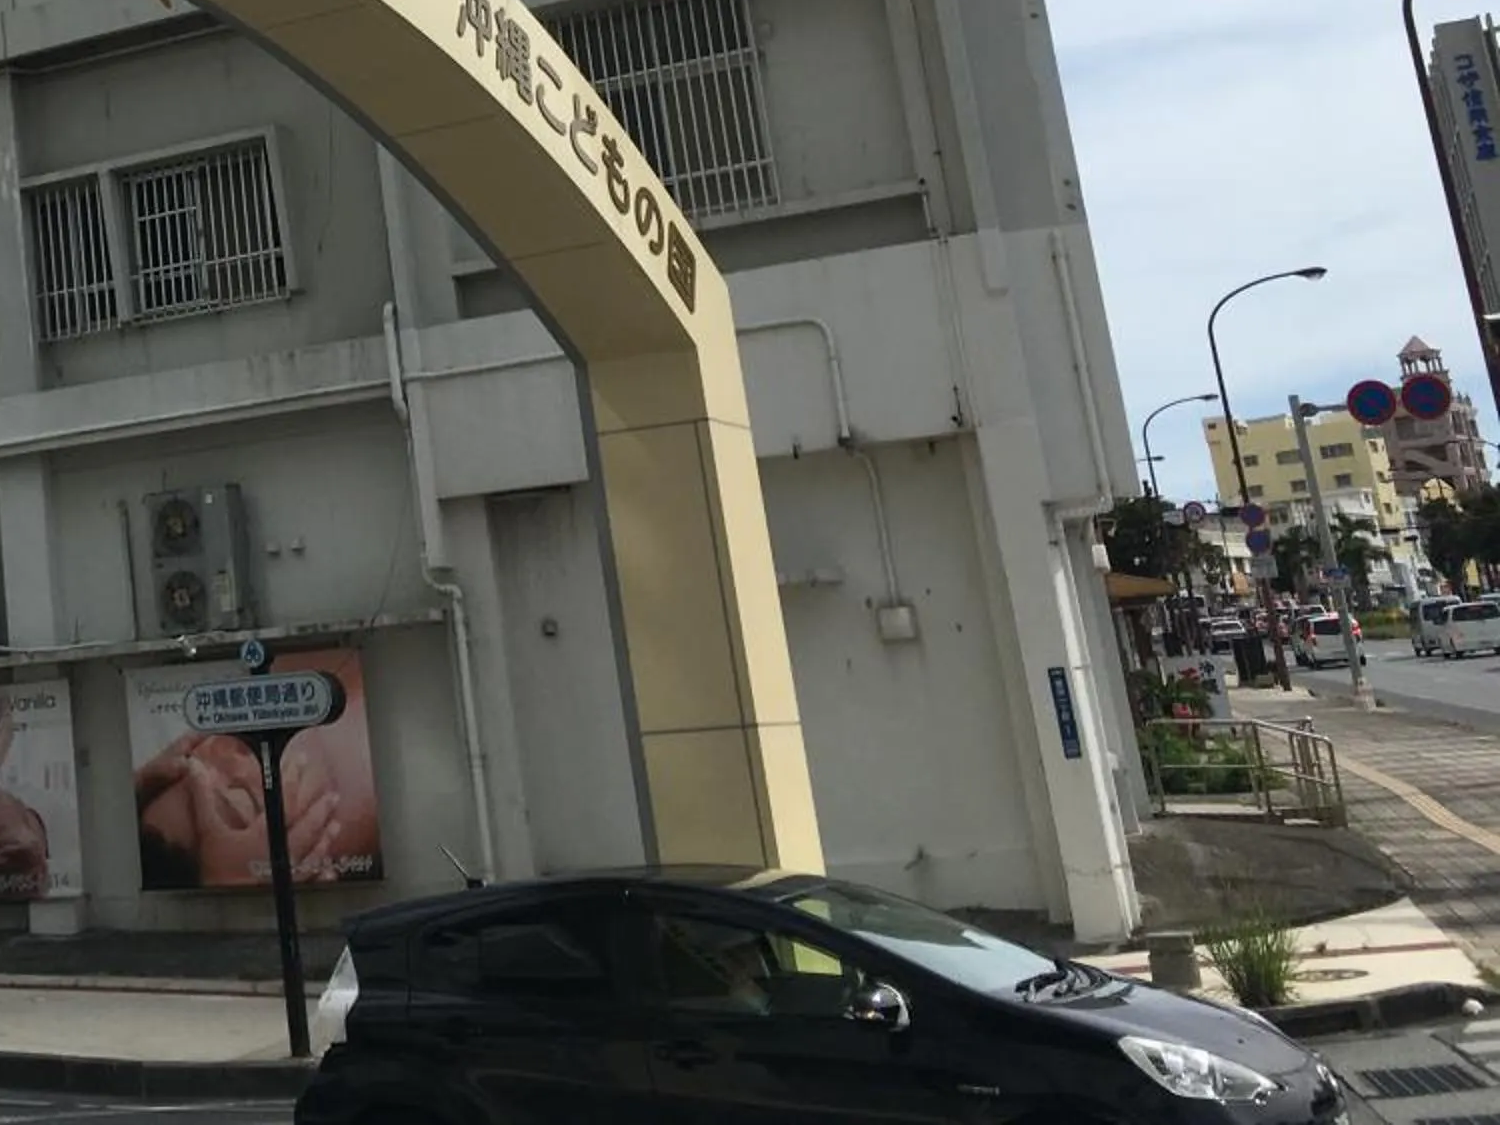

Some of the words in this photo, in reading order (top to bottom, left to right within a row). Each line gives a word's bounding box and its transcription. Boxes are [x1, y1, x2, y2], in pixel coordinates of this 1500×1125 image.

[195, 681, 316, 711] 沖縄郵便局通り
